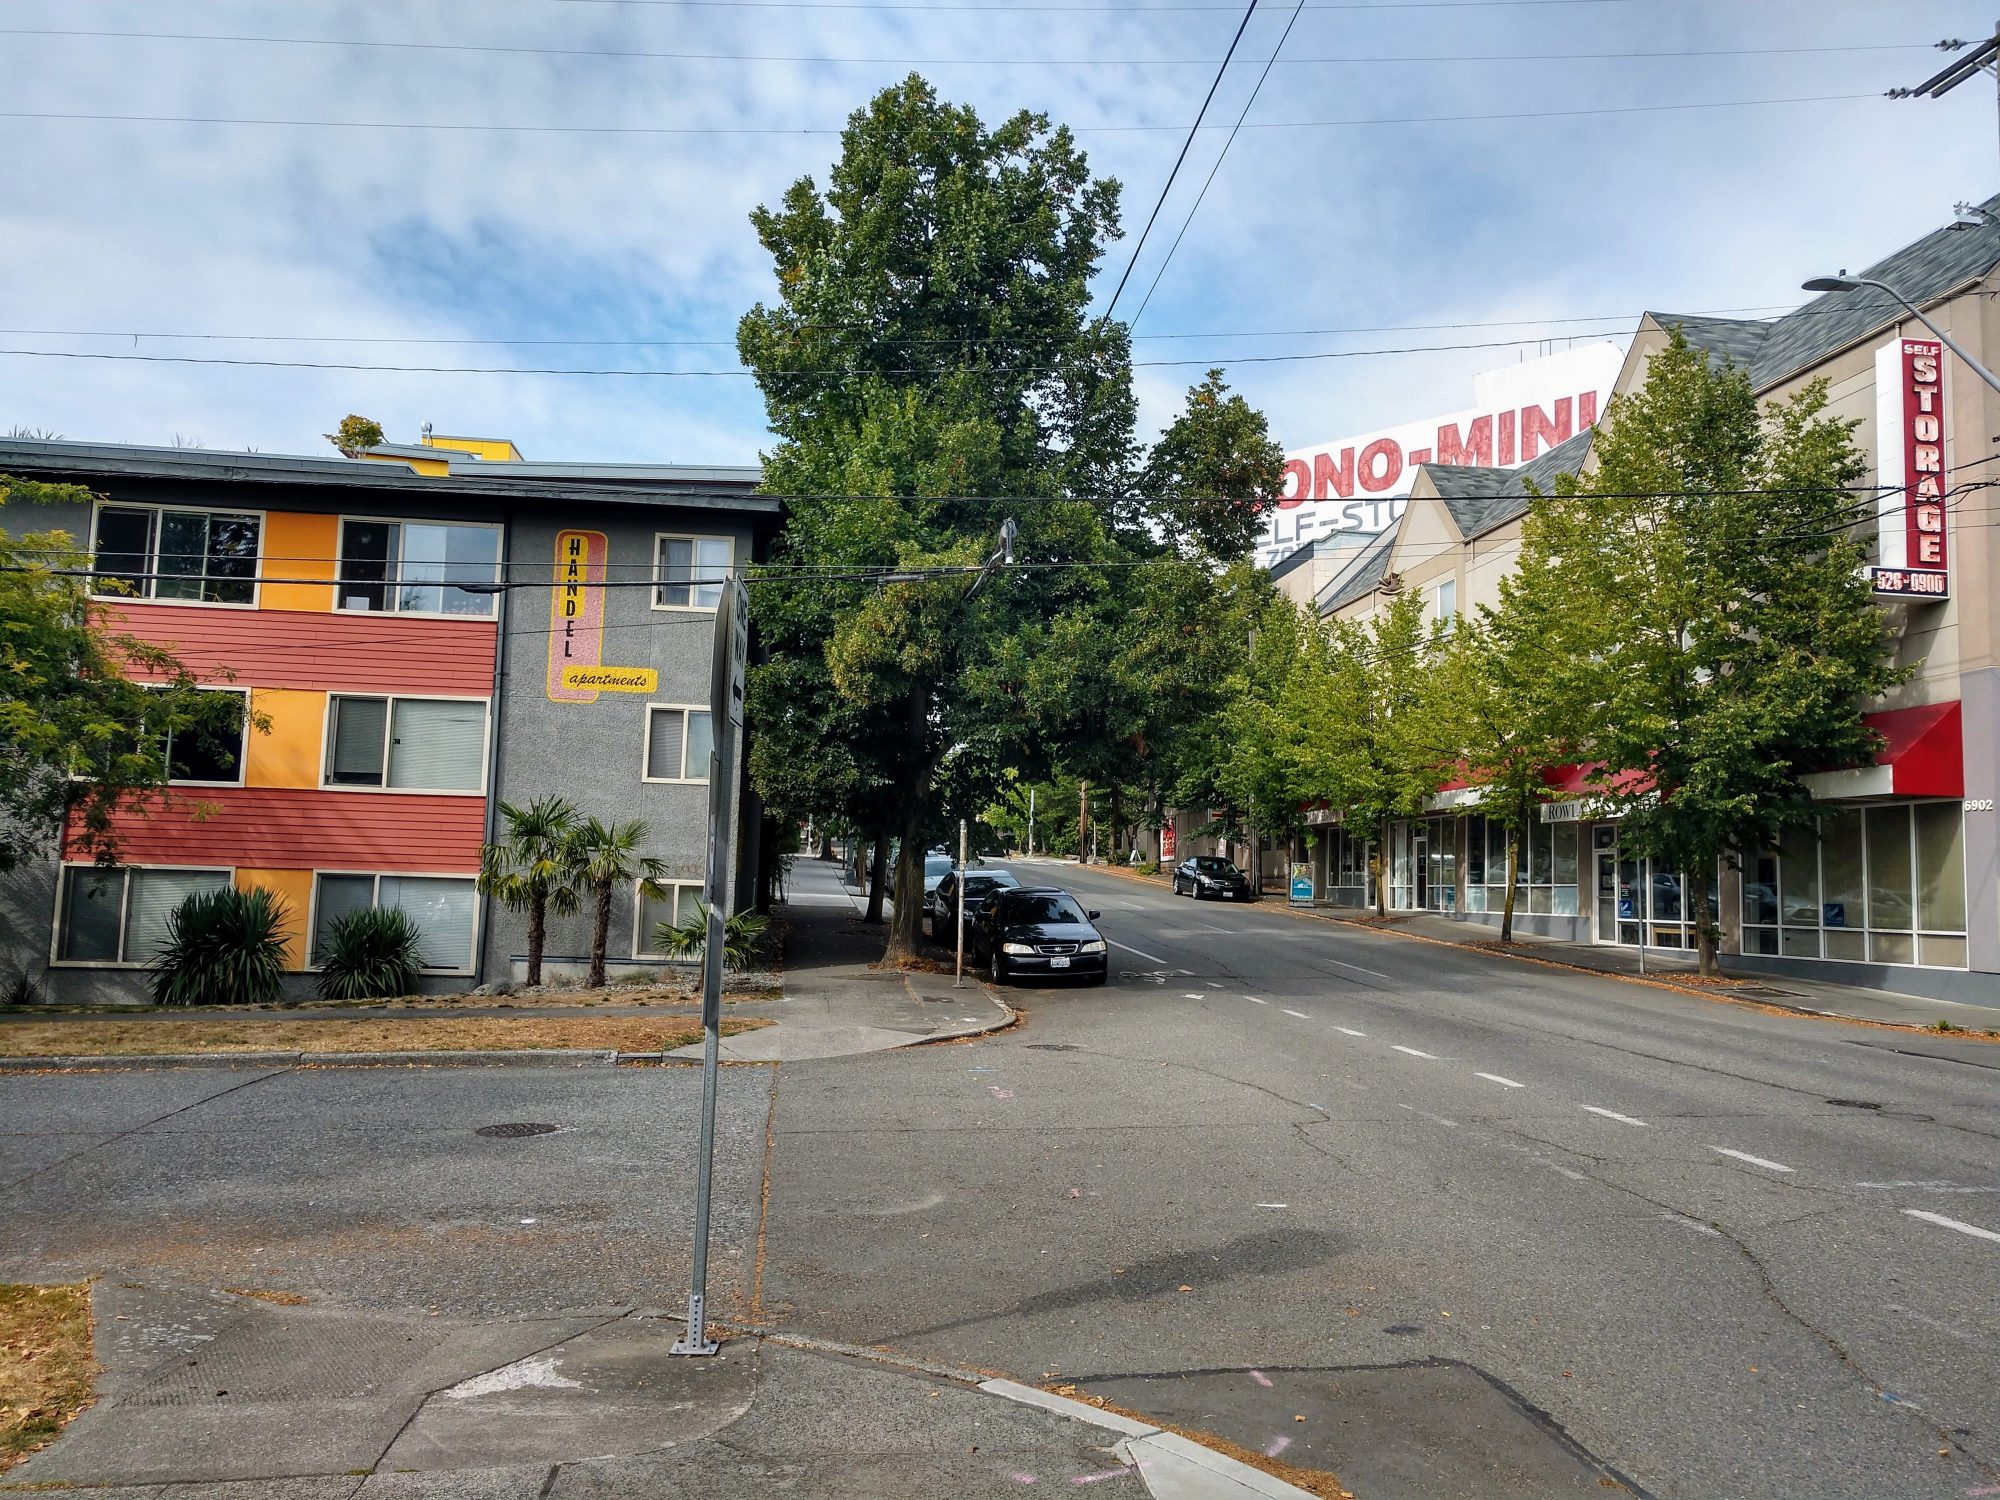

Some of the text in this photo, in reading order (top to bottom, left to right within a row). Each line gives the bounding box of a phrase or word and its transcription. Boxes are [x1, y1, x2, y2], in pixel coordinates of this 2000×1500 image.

[1903, 343, 1940, 356] SELF
[1914, 356, 1942, 563] STORAGE
[564, 538, 581, 658] HANDEL
[736, 588, 748, 632] ONE
[734, 626, 746, 670] WAY
[569, 673, 648, 688] apartments
[1964, 799, 1993, 811] 6902
